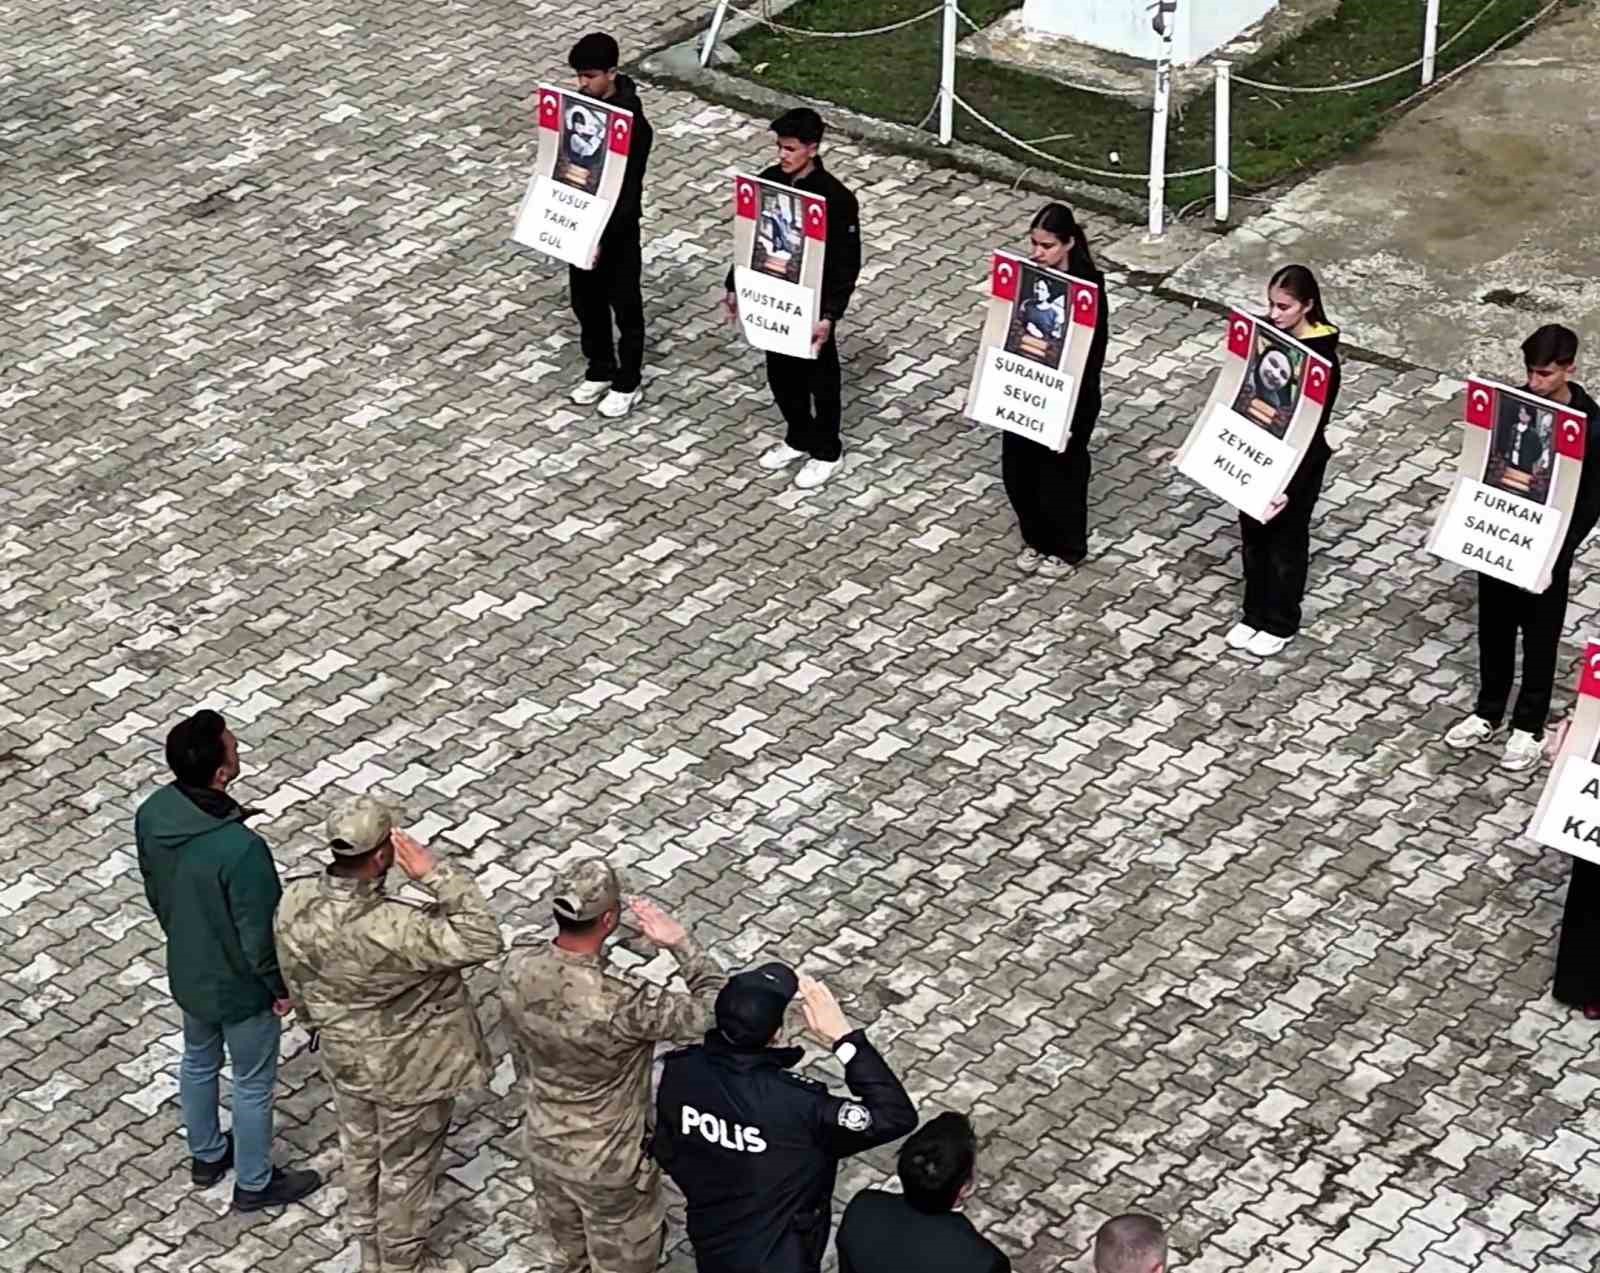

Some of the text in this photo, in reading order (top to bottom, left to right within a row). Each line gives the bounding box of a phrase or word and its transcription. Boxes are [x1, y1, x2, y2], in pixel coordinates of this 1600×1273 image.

[552, 188, 591, 211] YUSUF
[544, 208, 579, 232] TARIK
[741, 288, 803, 317] MUSTAFA
[745, 313, 790, 336] ASLAN
[1218, 428, 1274, 467] ZEYNEP
[1213, 455, 1252, 487] KILIÇ
[1474, 491, 1543, 525] FURKAN
[1464, 516, 1534, 551] SANCAK
[1461, 542, 1515, 572] BALAL
